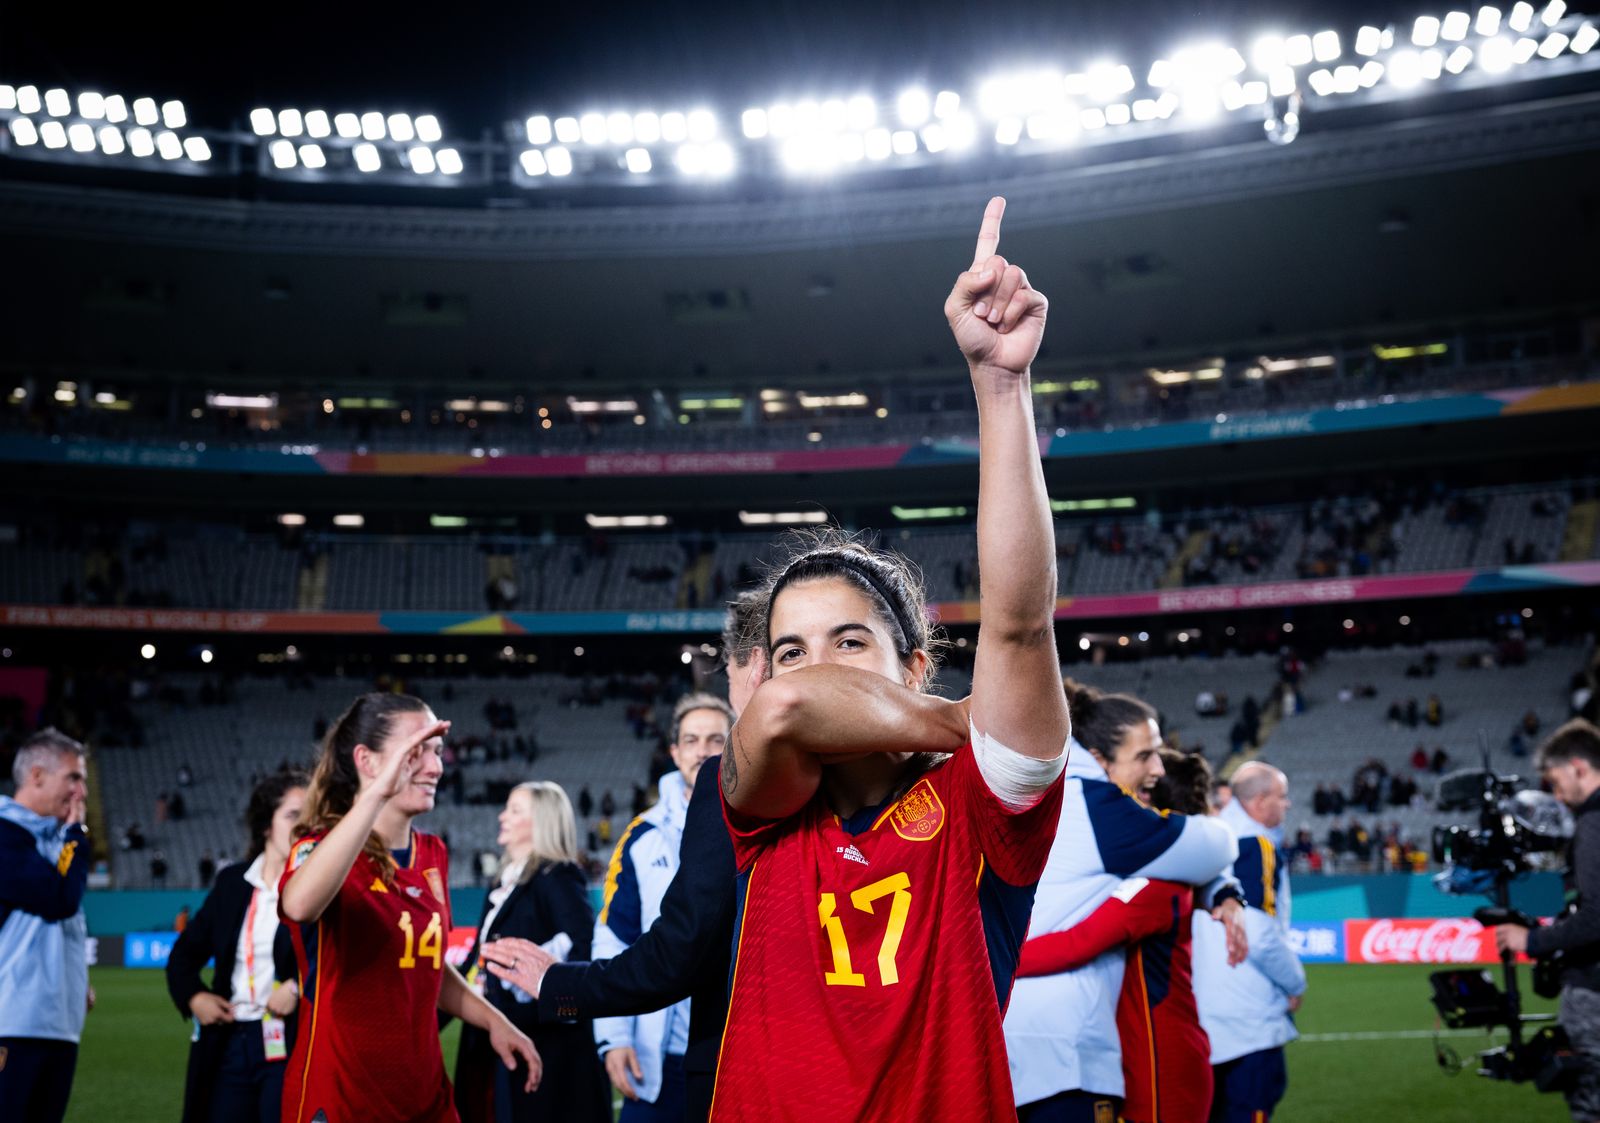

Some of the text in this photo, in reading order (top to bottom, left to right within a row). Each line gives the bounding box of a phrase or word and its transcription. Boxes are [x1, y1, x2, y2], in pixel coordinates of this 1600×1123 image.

[585, 452, 776, 473] BEYOND GREATNESS
[1158, 581, 1356, 611] BEYOND GREATNESS
[151, 610, 222, 630] WORLD
[225, 612, 268, 631] CUP
[398, 911, 442, 969] 14
[818, 872, 912, 987] 17
